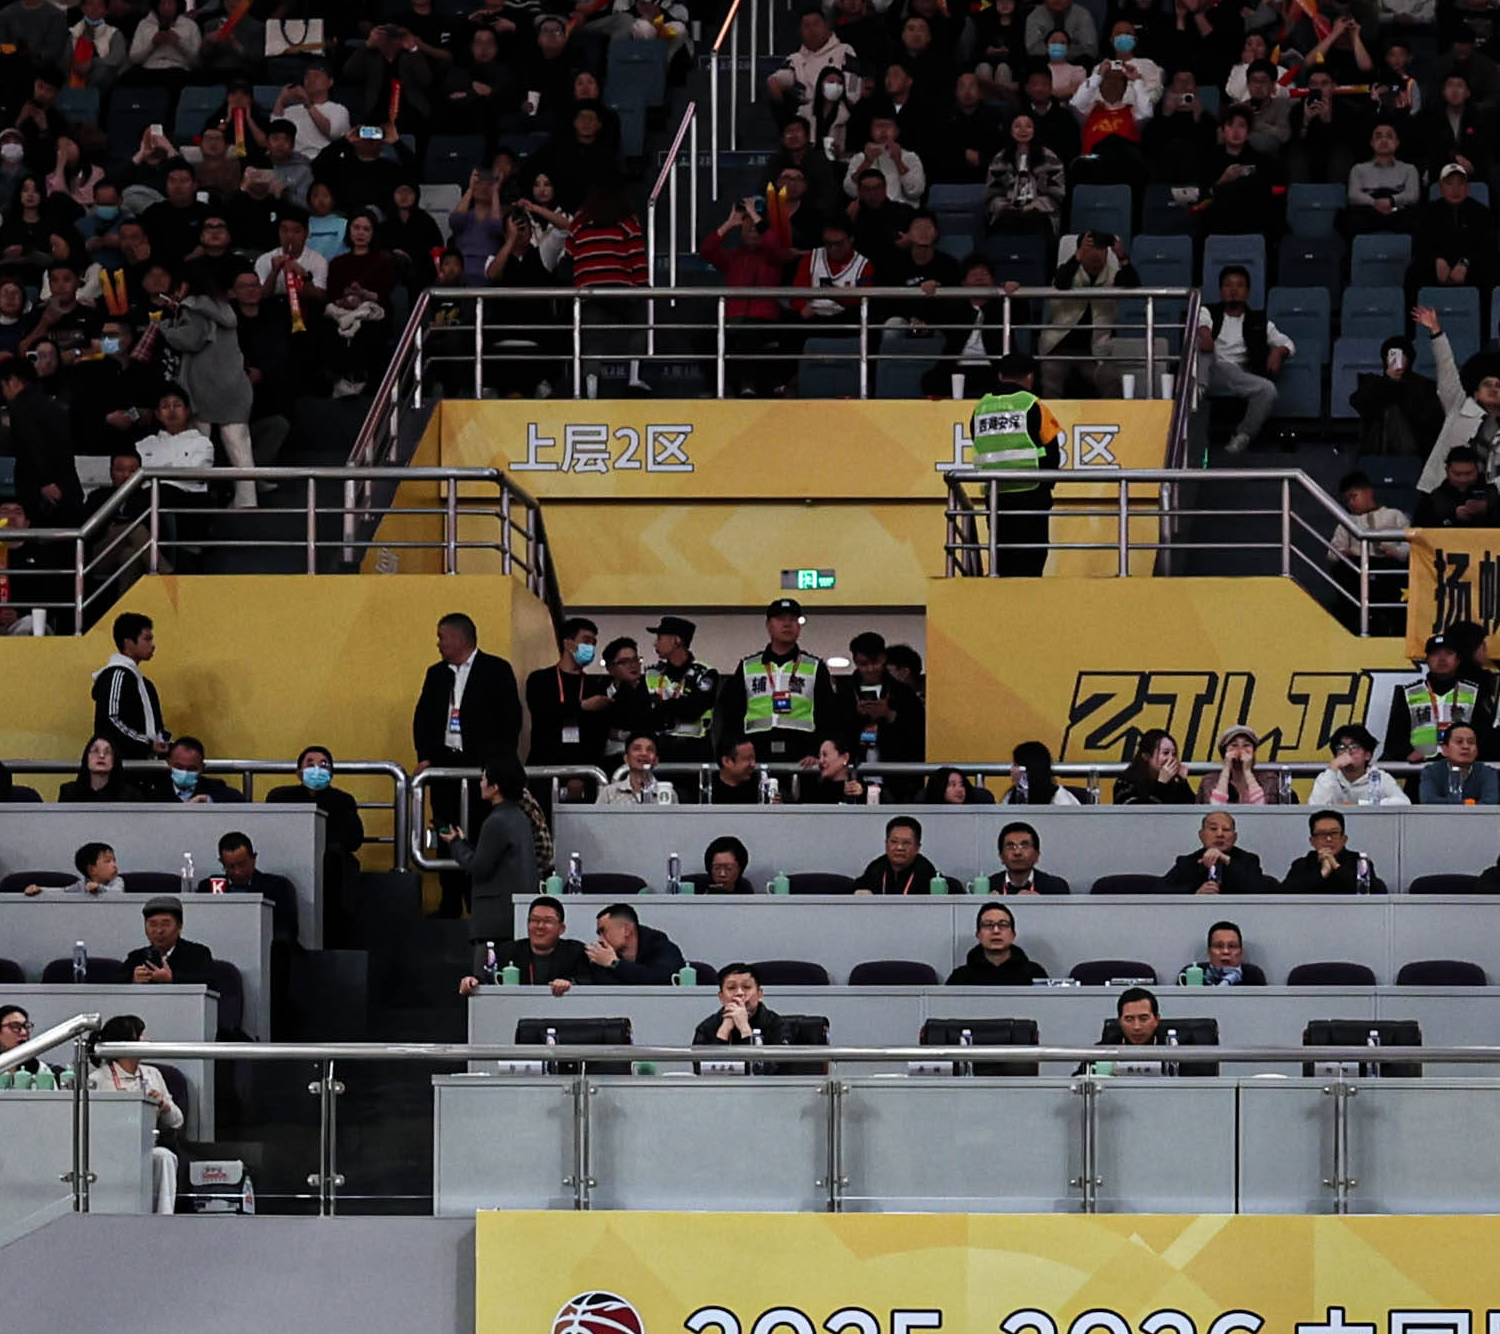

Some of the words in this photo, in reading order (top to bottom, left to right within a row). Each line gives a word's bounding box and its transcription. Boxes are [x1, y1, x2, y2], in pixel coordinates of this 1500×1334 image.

[509, 423, 695, 473] 上层2区
[935, 423, 1120, 471] 上区
